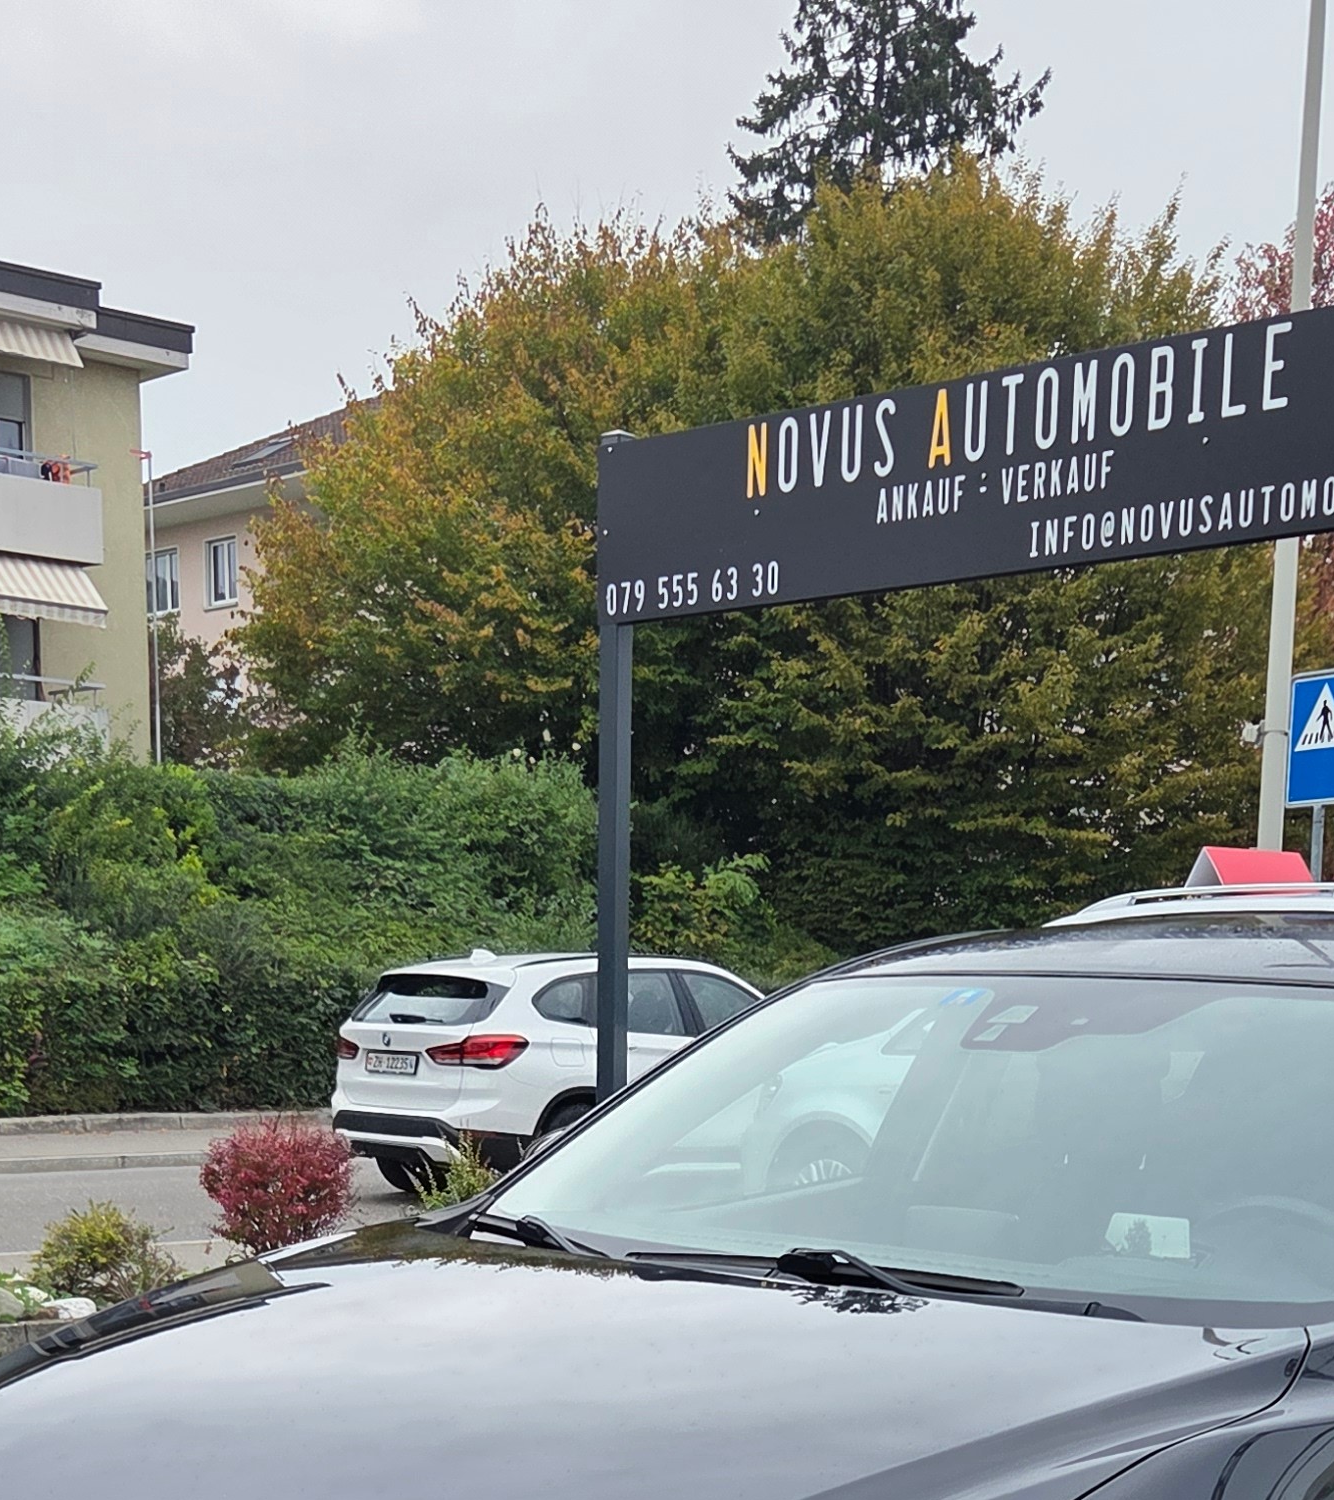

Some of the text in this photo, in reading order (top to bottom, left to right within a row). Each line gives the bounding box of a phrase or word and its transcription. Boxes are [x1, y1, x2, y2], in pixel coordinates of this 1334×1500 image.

[746, 321, 1293, 499] NOVUS AUTOMOBILE
[876, 474, 966, 525] ANKAUF
[1001, 449, 1115, 505] VERKAUF
[606, 560, 779, 616] 079 555 63 30
